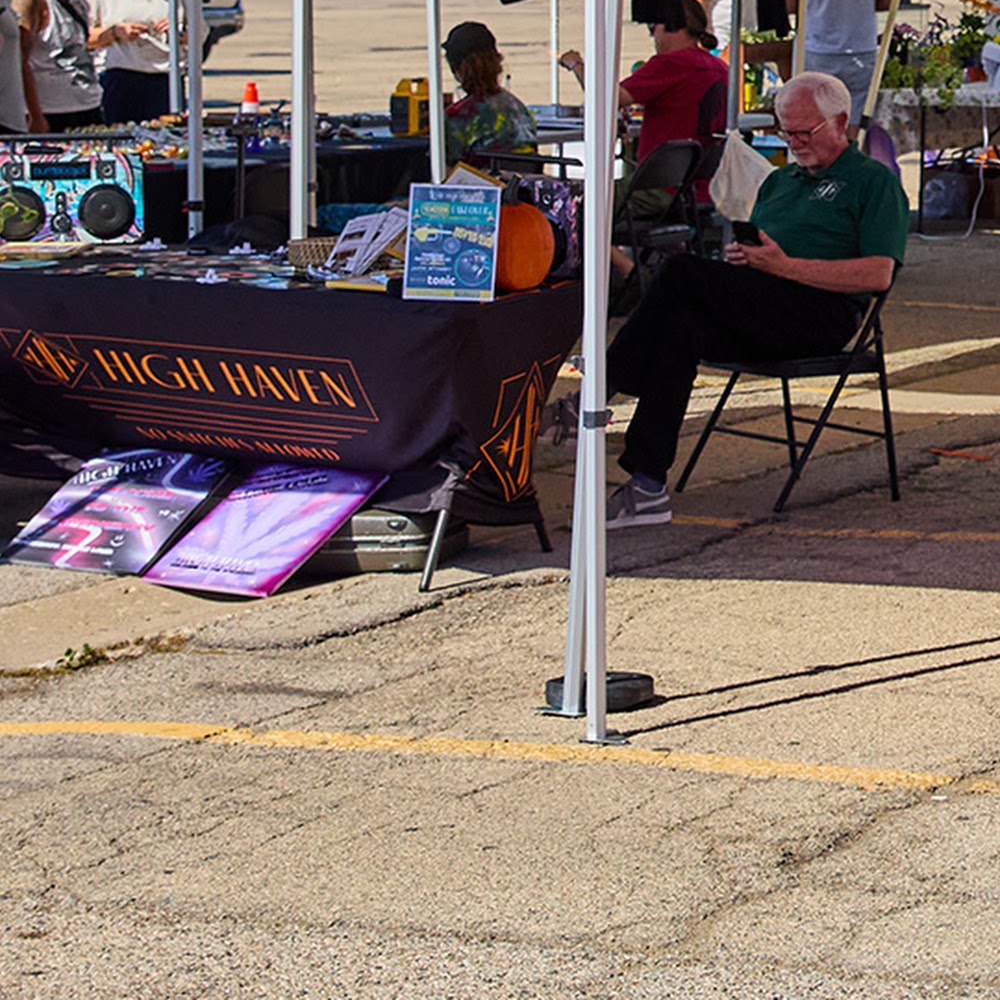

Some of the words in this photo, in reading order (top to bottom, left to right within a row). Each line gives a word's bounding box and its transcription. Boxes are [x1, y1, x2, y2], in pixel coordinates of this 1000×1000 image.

[427, 275, 456, 286] tonic
[93, 349, 216, 393] HIGH
[220, 361, 356, 408] HAVEN
